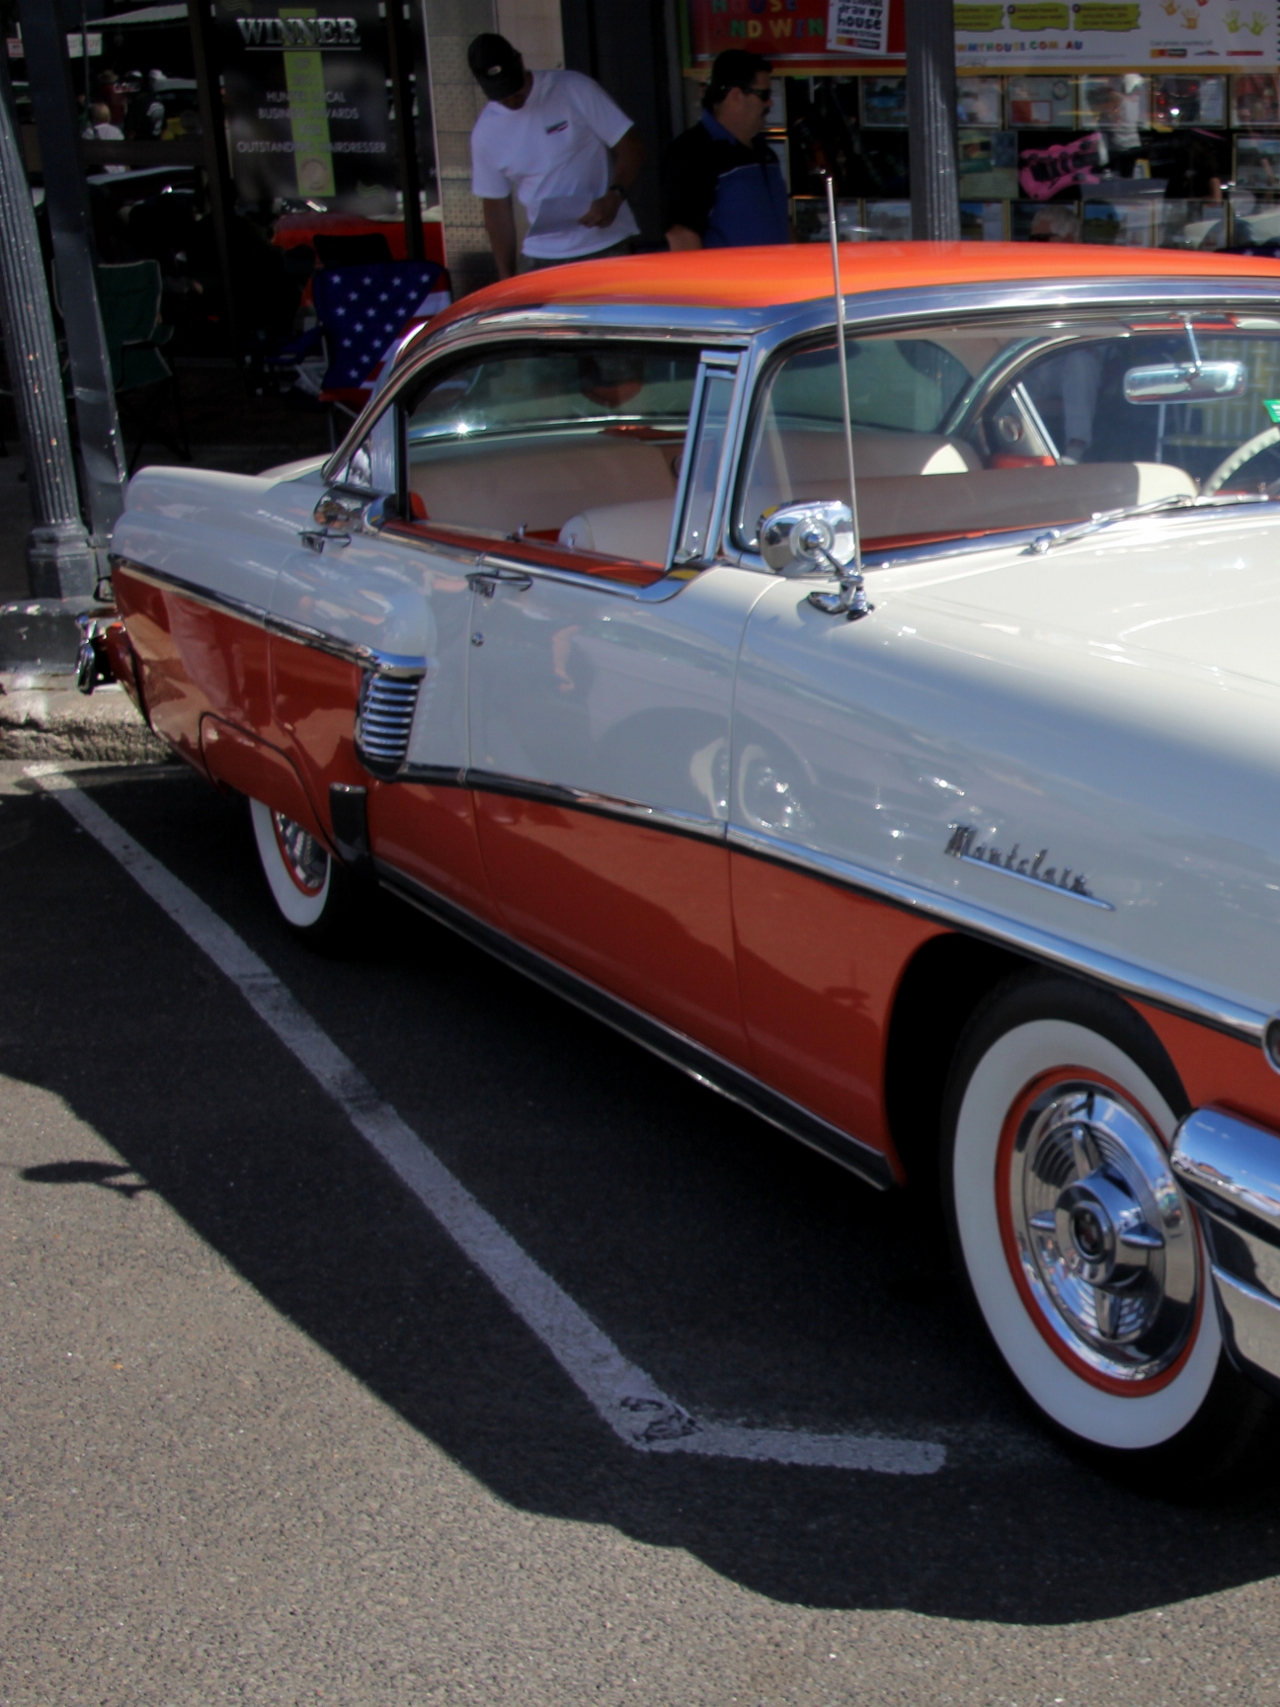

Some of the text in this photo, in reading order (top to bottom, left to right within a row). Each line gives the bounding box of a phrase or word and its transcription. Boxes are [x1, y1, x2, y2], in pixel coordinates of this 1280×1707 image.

[236, 17, 361, 45] WINNER
[768, 18, 824, 39] WIN
[837, 13, 882, 30] house
